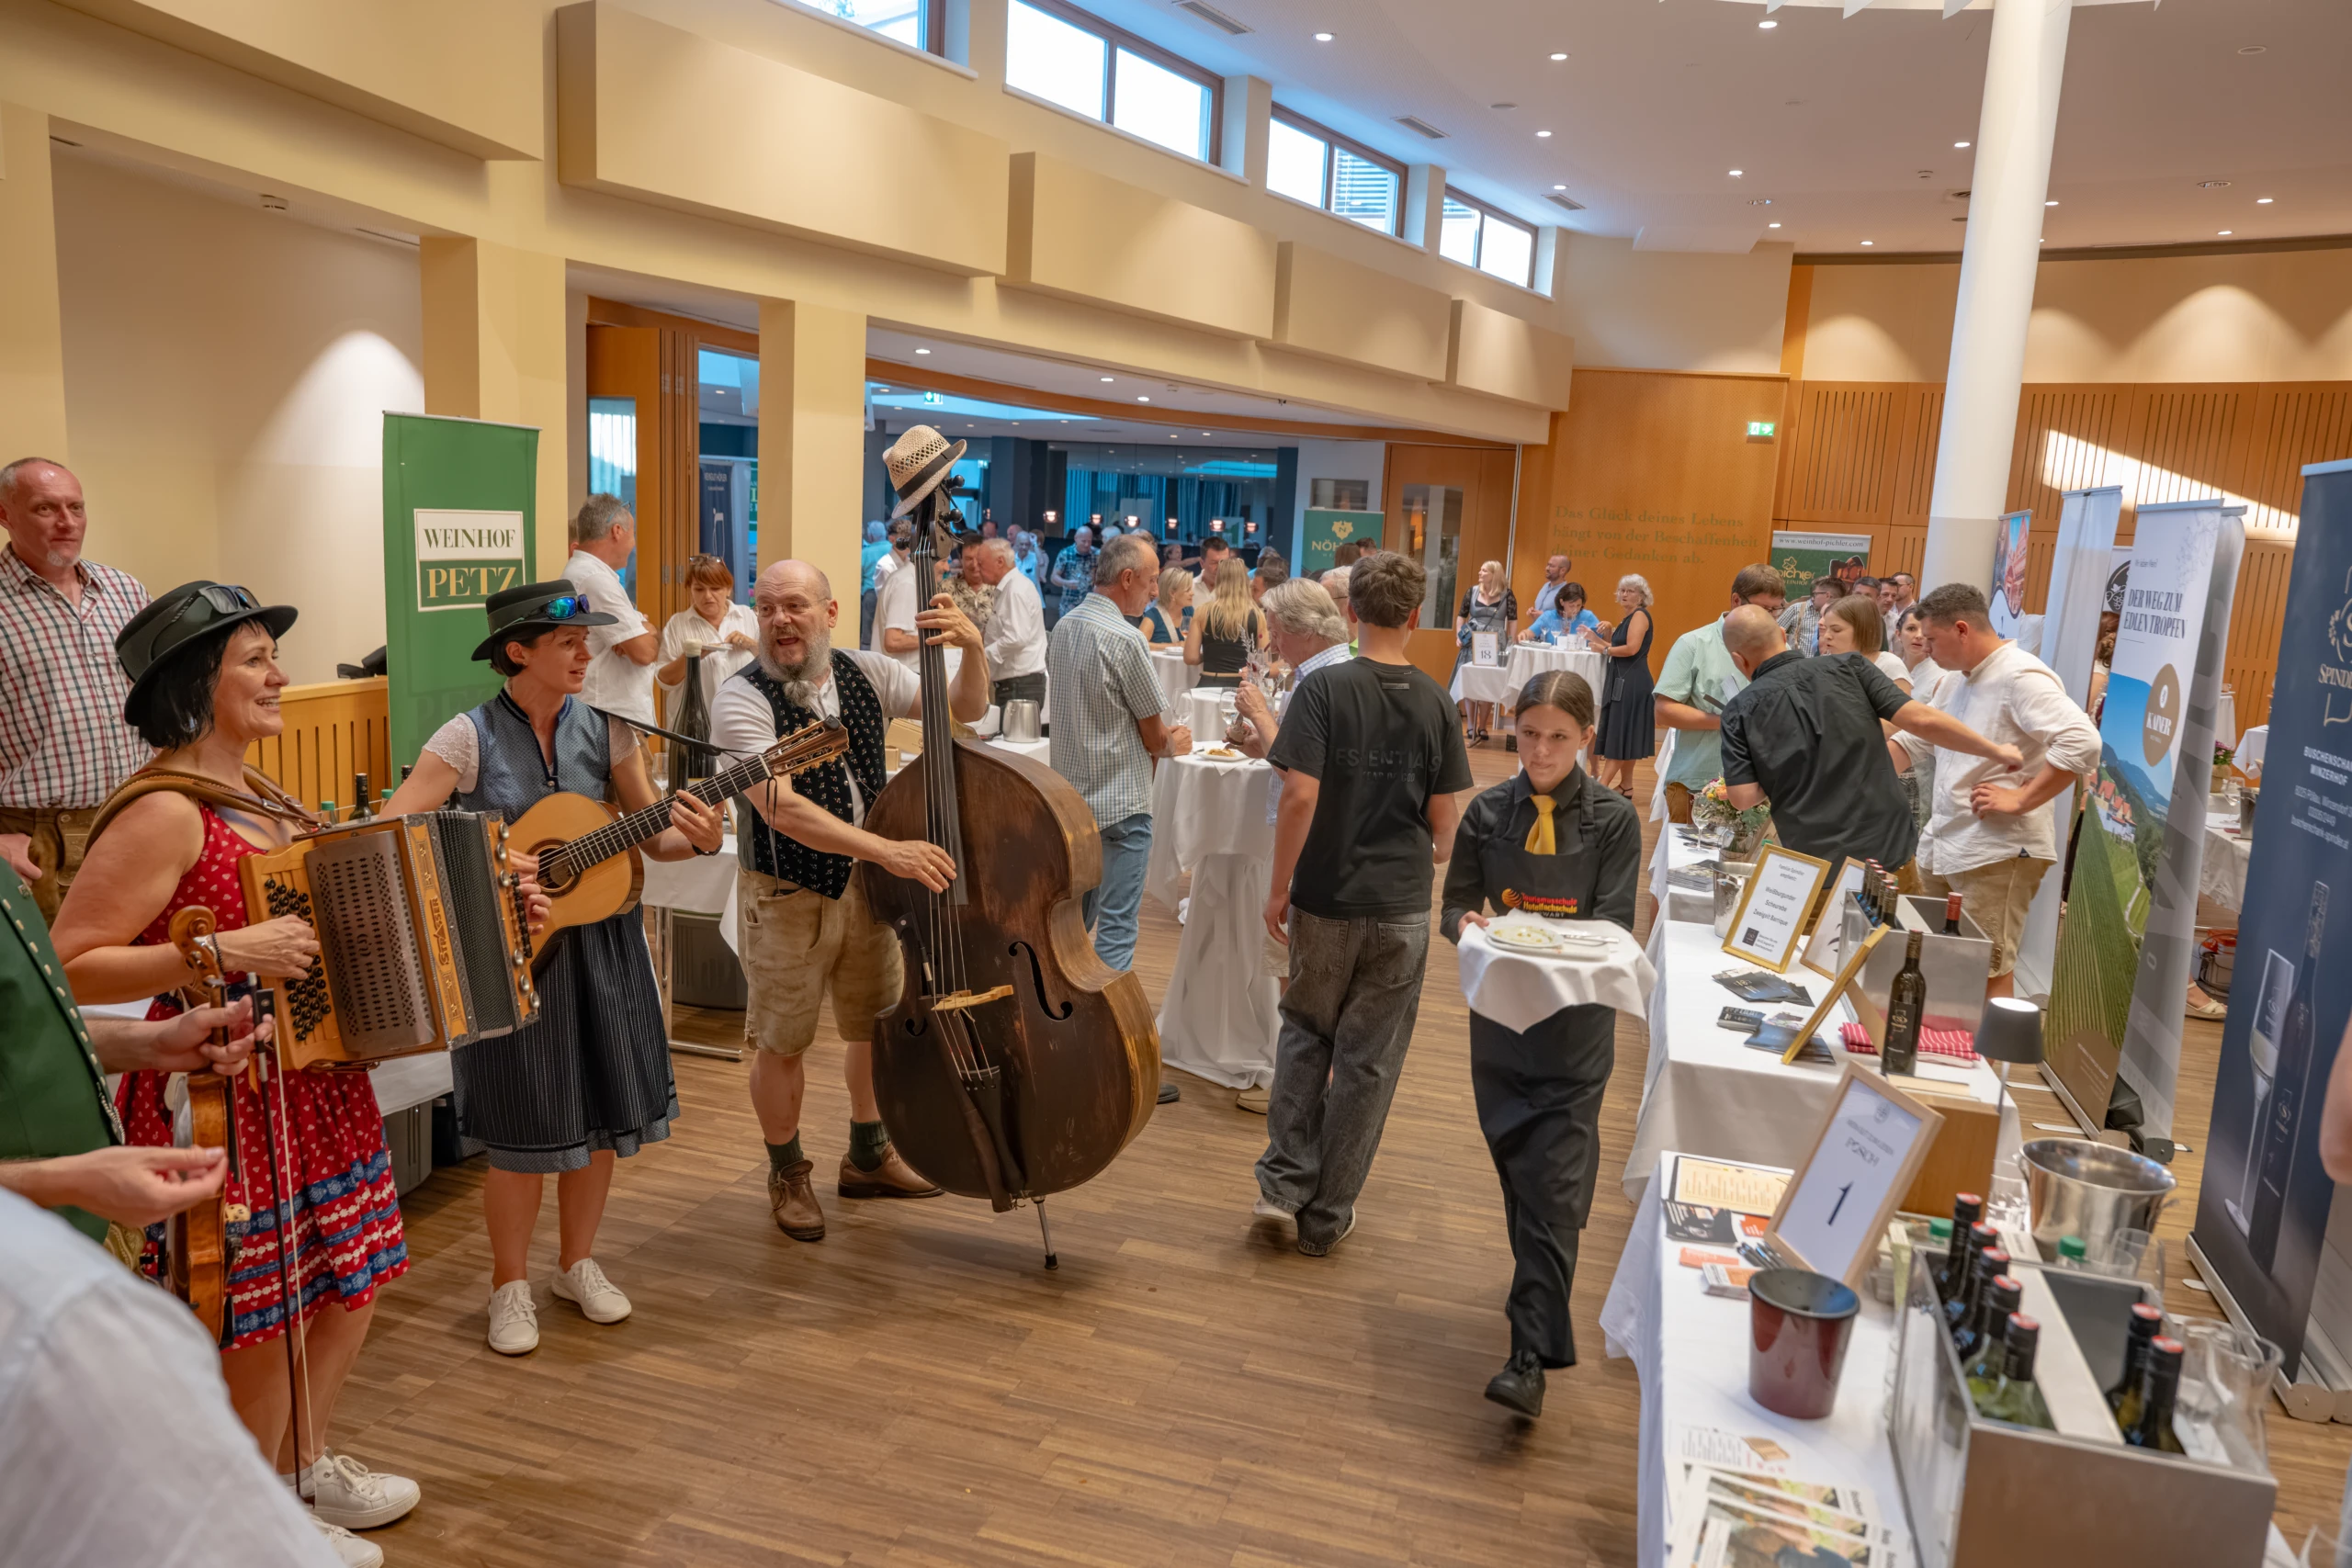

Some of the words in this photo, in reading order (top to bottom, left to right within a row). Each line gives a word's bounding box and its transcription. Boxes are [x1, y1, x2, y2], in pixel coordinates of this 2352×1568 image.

[1555, 506, 1583, 519] Das
[1589, 506, 1633, 522] Glück
[1637, 510, 1685, 525] deines
[1691, 512, 1744, 527] Lebens
[423, 528, 516, 549] WEINHOF
[1553, 525, 1591, 542] hängt
[1596, 530, 1622, 540] von
[1625, 527, 1649, 542] der
[1654, 530, 1758, 547] Beschaffenheit
[1779, 537, 1864, 548] www.weinhof-pichler.com
[1603, 547, 1678, 562] Gedanken
[1682, 550, 1704, 564] ab.
[426, 567, 517, 599] PETZ
[2127, 589, 2145, 608] DER
[2145, 590, 2165, 611] WEG
[2163, 592, 2183, 613] ZUM
[2123, 611, 2148, 633] EDLEN
[2148, 615, 2186, 639] TROPFEN
[1481, 649, 1491, 660] 18
[1521, 892, 1577, 906] Tourismusschule
[1522, 900, 1577, 914] Hotelfachschule
[1827, 1179, 1855, 1227] 1
